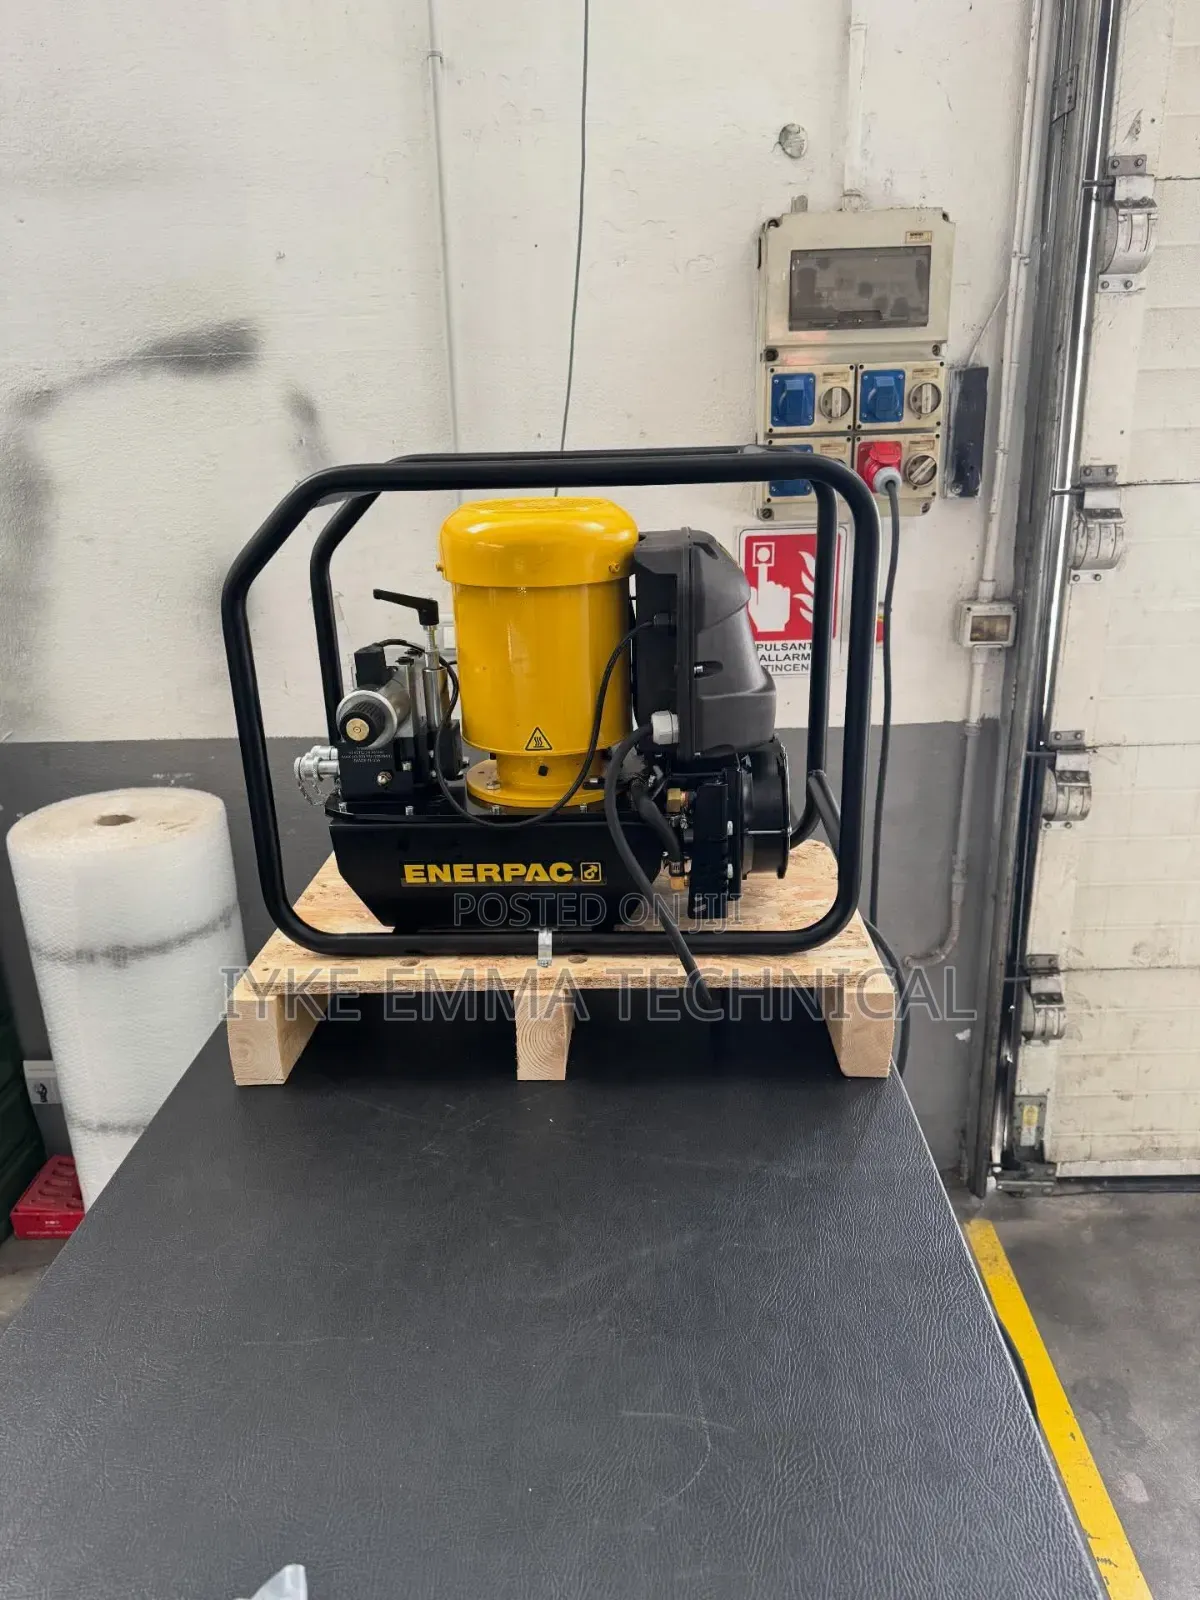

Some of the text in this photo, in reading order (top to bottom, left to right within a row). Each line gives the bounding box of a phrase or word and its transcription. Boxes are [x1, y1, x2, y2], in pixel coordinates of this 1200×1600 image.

[756, 642, 813, 651] PULSANT
[760, 653, 811, 662] ALLARM
[762, 663, 810, 672] TINCEN
[404, 862, 573, 884] ENERPAC
